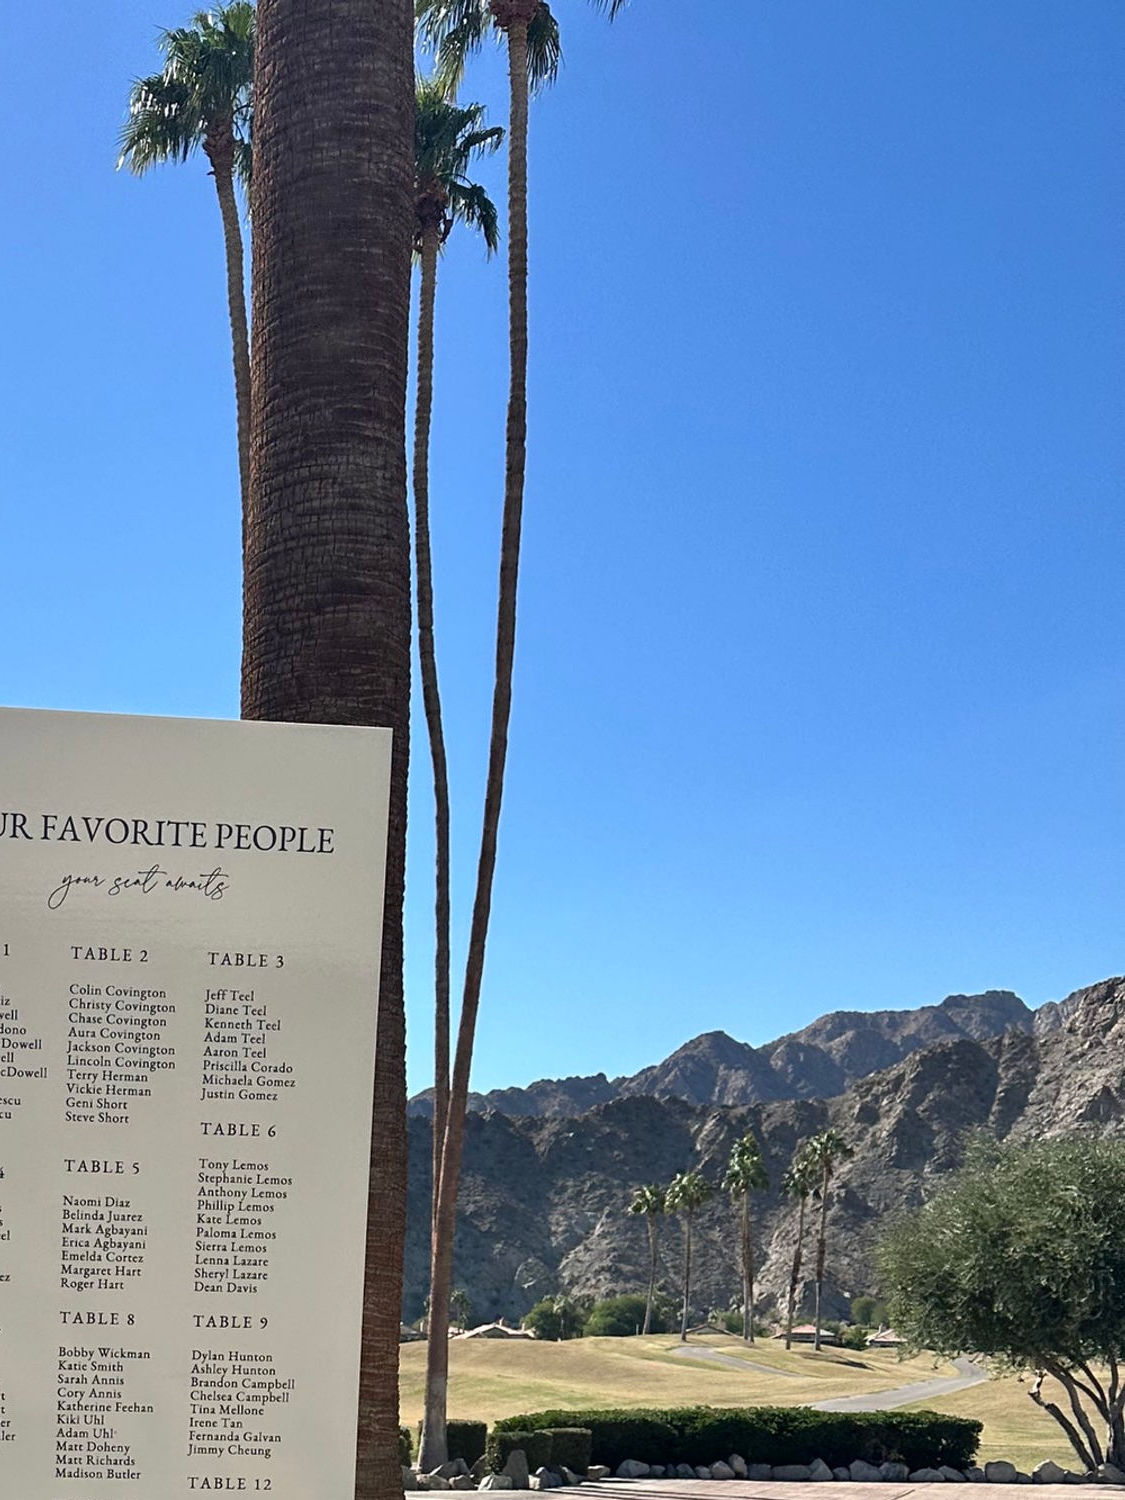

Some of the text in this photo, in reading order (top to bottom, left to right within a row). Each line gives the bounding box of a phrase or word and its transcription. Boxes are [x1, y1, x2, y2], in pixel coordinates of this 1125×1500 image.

[41, 815, 207, 848] FAVORITE
[215, 824, 334, 853] PEOPLE
[48, 864, 229, 910] your seat awaits
[4, 944, 9, 956] 1
[71, 946, 148, 963] TABLE 2
[208, 952, 284, 969] TABLE 3
[69, 984, 166, 1002] Colin Covington
[69, 998, 176, 1017] Christy Covington
[205, 1003, 267, 1016] Diane Teel
[205, 1017, 281, 1031] Kenneth Teel
[203, 1060, 293, 1074] Priscilla Corado
[67, 1068, 148, 1085] Terry Herman
[200, 1088, 278, 1101] Justin Gomez
[66, 1097, 128, 1110] Geni Short
[200, 1122, 276, 1138] TABLE 6
[64, 1159, 140, 1175] TABLE 5
[199, 1158, 269, 1175] Tony Lemos
[63, 1195, 131, 1208] Naomi Diaz
[62, 1222, 148, 1239] Mark Agbayani
[196, 1227, 277, 1240] Paloma Lemos
[62, 1250, 144, 1263] Emelda Cortez
[195, 1254, 269, 1267] Lenna Lazare
[61, 1264, 142, 1279] Margaret Hart
[60, 1311, 135, 1326] TABLE 8
[193, 1315, 268, 1329] TABLE 9
[59, 1346, 151, 1362] Bobby Wickman
[192, 1350, 273, 1365] Dylan Hunton
[57, 1373, 125, 1386] Sarah Annis
[191, 1375, 295, 1394] Brandon Campbell
[57, 1399, 154, 1413] Katherine Feehan
[190, 1403, 265, 1416] Tina Mellone
[55, 1467, 141, 1480] Madison Butler
[187, 1477, 272, 1491] TABLE 12
